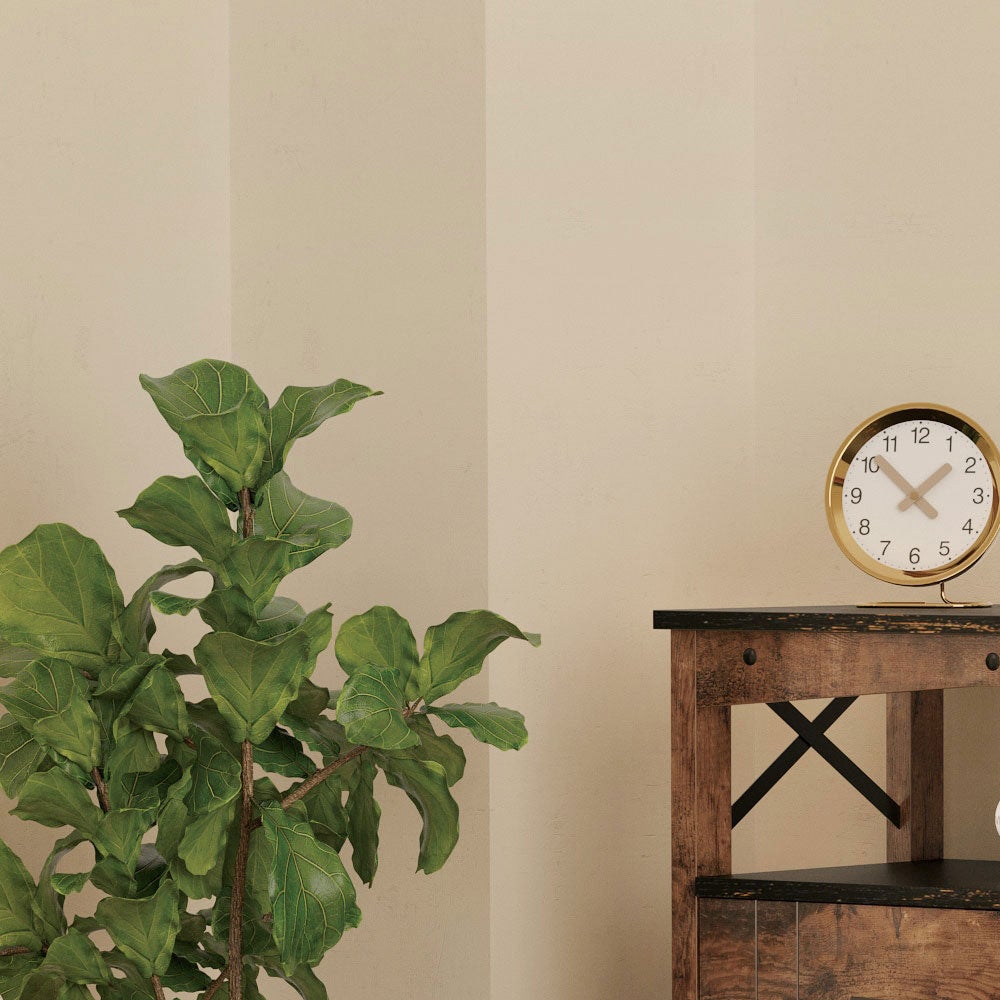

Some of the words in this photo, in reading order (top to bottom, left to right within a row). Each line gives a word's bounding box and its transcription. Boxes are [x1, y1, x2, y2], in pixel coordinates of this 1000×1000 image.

[882, 435, 897, 453] 11
[910, 426, 930, 444] 12
[945, 435, 953, 453] 1
[861, 456, 880, 474] 10
[964, 456, 977, 474] 2
[850, 487, 862, 504] 9
[972, 487, 984, 504] 3
[858, 518, 871, 536] 8
[961, 518, 973, 535] 4
[879, 540, 892, 556] 7
[908, 547, 921, 565] 6
[938, 540, 951, 556] 5
